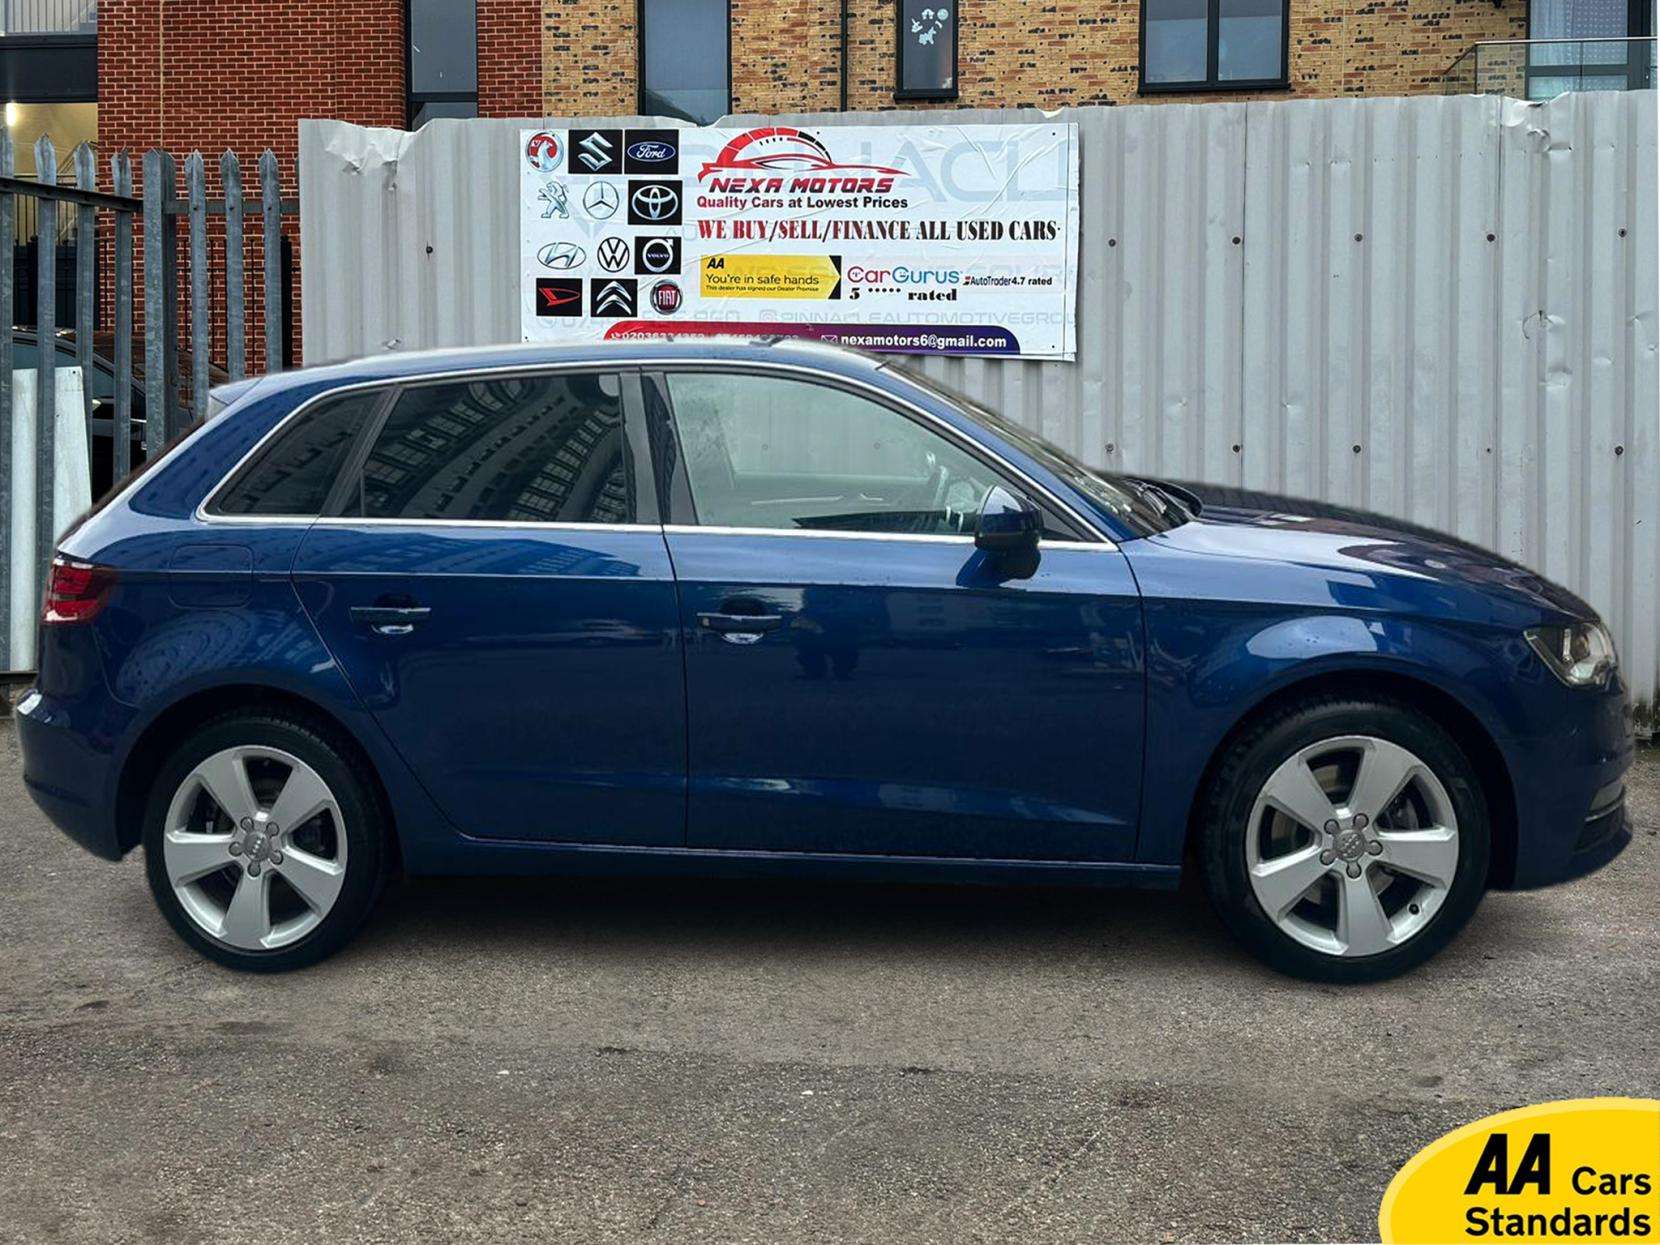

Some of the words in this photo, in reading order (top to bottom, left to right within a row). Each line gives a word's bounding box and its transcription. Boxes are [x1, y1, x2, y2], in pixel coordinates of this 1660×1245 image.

[636, 144, 666, 158] Ford
[709, 178, 784, 193] NEXA
[789, 178, 894, 193] MOTORS
[697, 196, 747, 210] Quality
[751, 196, 784, 208] Cars
[788, 196, 803, 208] at
[807, 196, 859, 208] Lowest
[863, 196, 908, 208] Prices
[698, 220, 727, 239] WE
[916, 220, 951, 240] ALL
[956, 220, 1003, 240] USED
[707, 258, 725, 269] AA
[706, 274, 741, 284] You're
[744, 274, 754, 284] in
[757, 274, 780, 284] safe
[784, 275, 819, 285] hands
[847, 266, 960, 284] CarGurus
[1028, 277, 1052, 285] rated
[658, 290, 676, 306] FIAT
[850, 288, 860, 300] 5
[908, 288, 957, 301] rated
[841, 334, 1007, 349] nexamotors6@gmail.com
